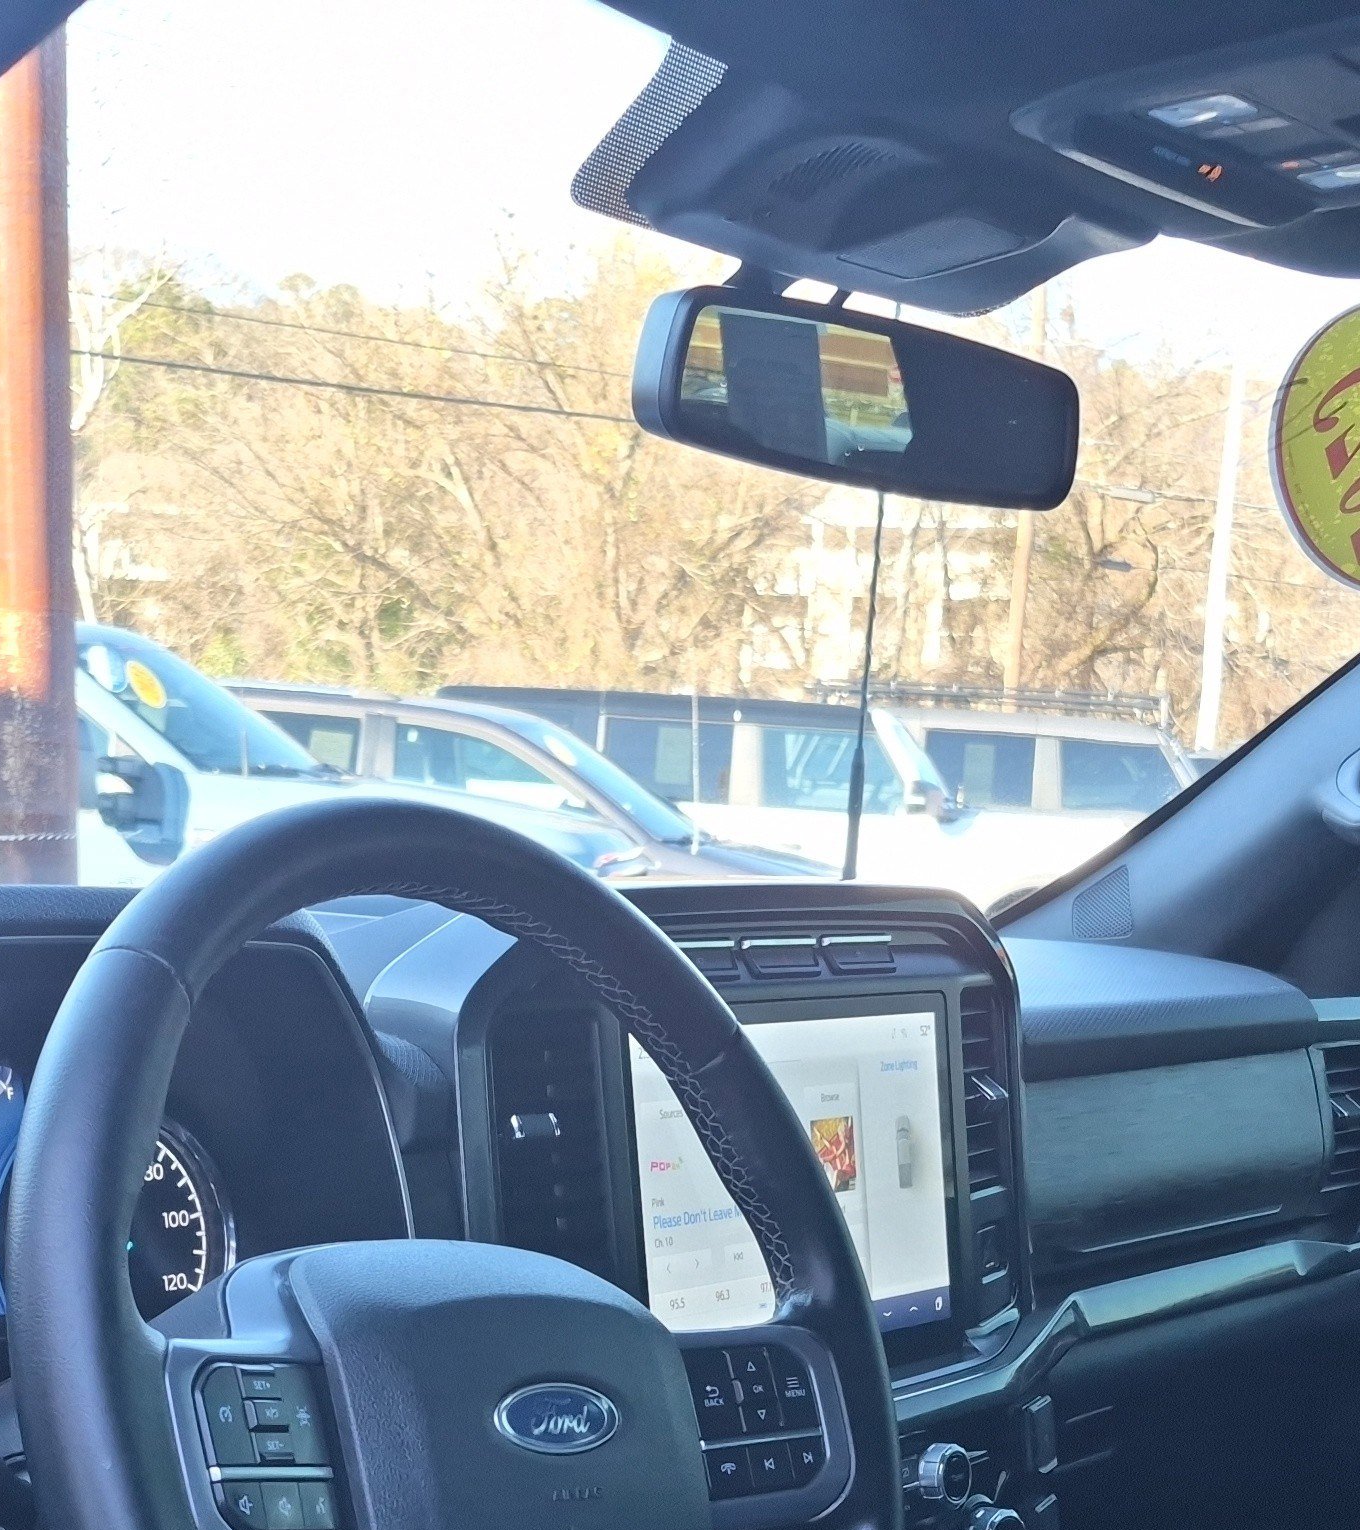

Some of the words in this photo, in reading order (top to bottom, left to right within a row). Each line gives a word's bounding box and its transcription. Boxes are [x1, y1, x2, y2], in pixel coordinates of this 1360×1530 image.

[6, 1086, 15, 1101] F
[161, 1209, 190, 1229] 100
[652, 1214, 682, 1230] Please
[683, 1209, 707, 1225] Don't
[708, 1206, 733, 1222] Leave
[665, 1236, 674, 1247] 10
[162, 1272, 188, 1292] 120
[715, 1289, 731, 1302] 96.3
[669, 1297, 686, 1311] 95.5
[784, 1388, 806, 1398] MENU
[703, 1398, 725, 1408] BACK
[530, 1397, 591, 1437] Ford
